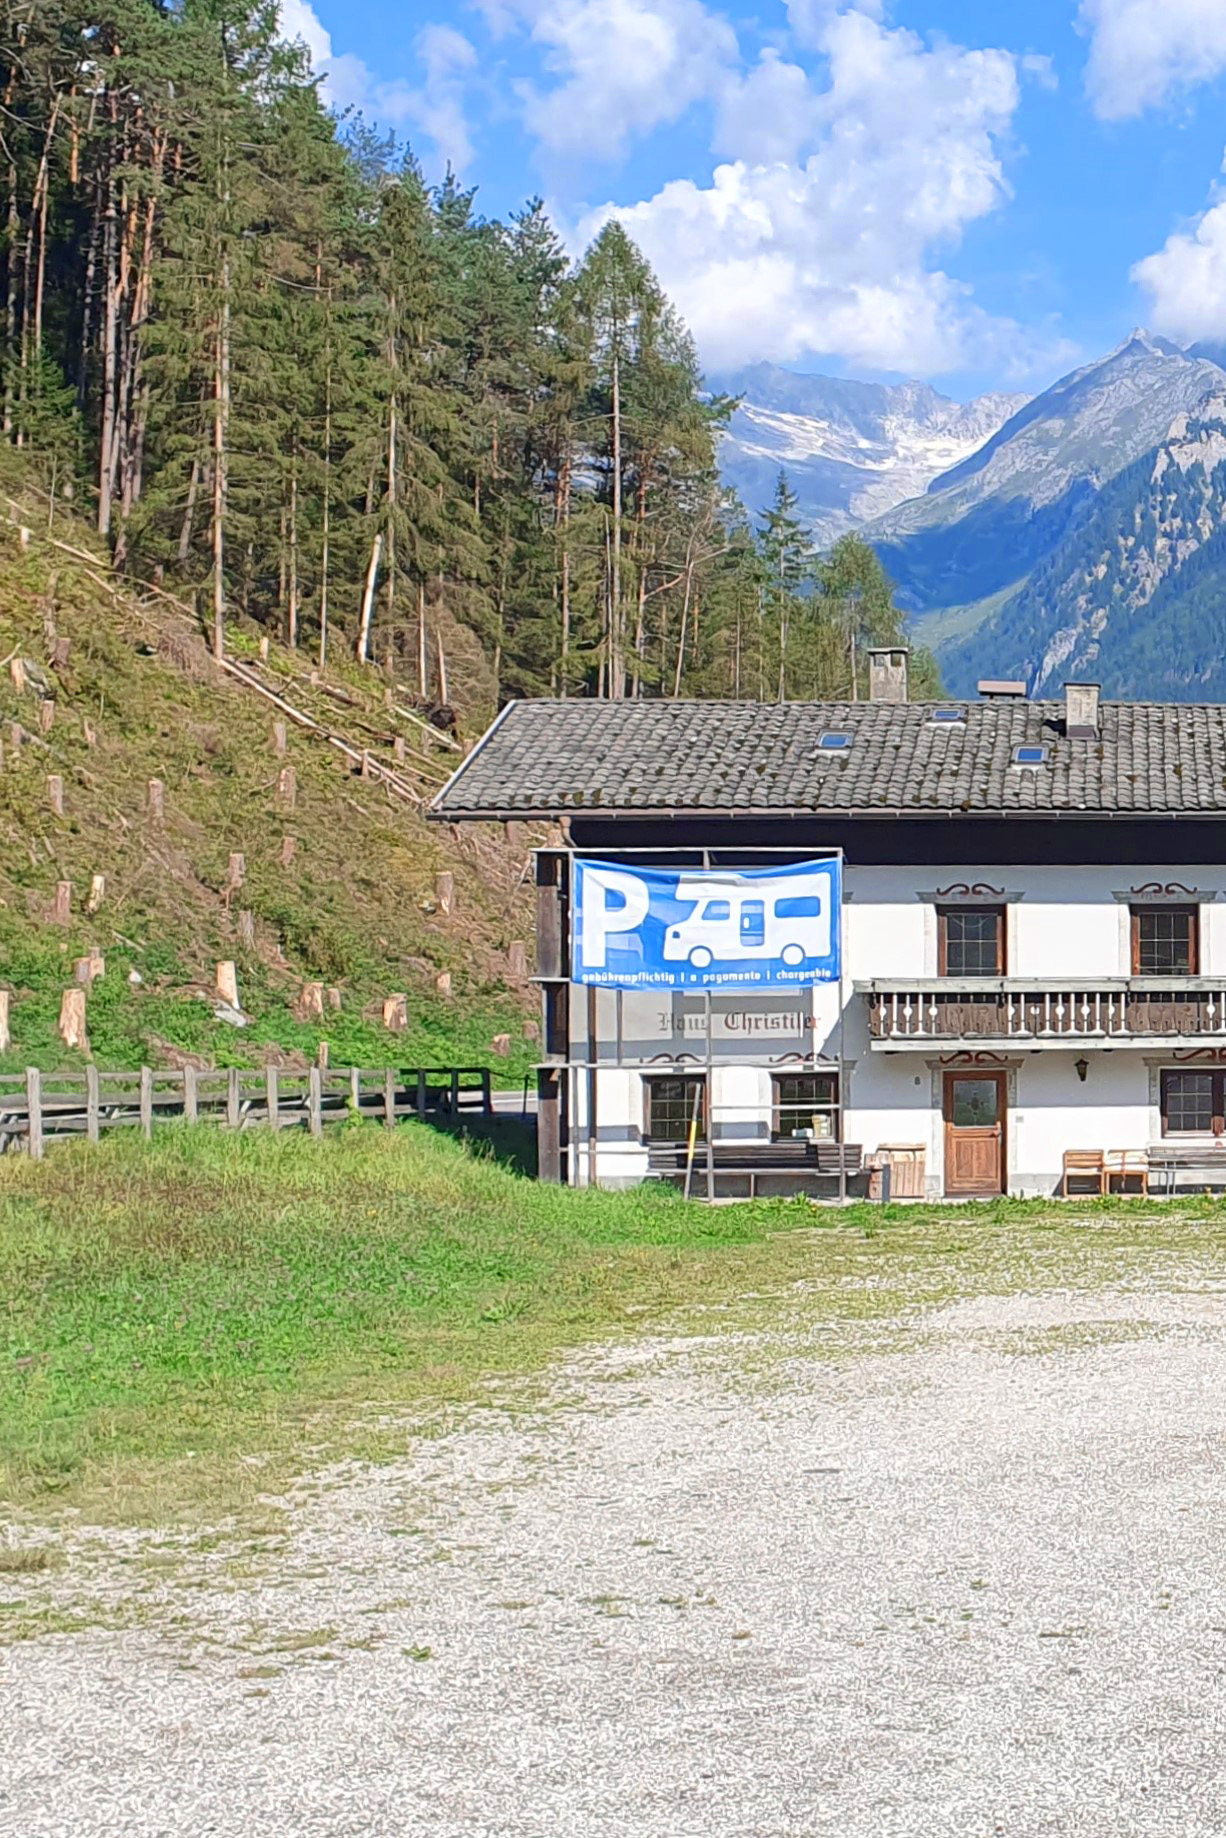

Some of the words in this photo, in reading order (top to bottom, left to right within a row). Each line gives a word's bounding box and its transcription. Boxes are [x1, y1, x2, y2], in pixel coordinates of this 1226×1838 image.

[582, 868, 649, 967] P
[582, 971, 675, 985] gebührenpflichtig
[702, 971, 761, 984] pagamento
[776, 967, 832, 981] chargeable
